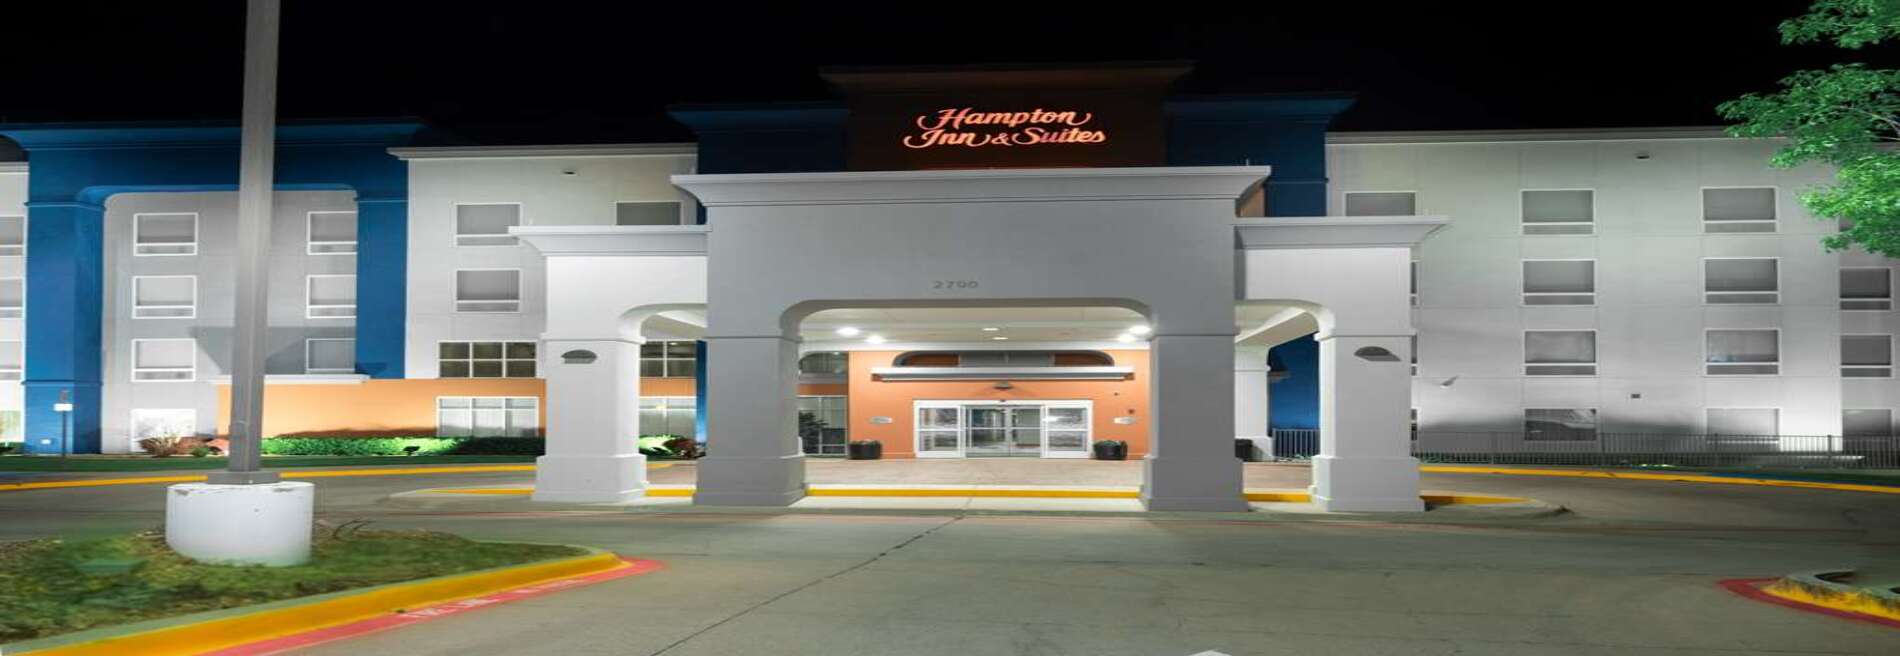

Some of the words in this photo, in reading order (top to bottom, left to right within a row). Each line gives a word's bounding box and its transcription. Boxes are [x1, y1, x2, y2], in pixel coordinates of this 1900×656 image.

[917, 107, 1091, 129] Hampton
[903, 129, 990, 148] Inn
[991, 132, 1013, 146] &
[1012, 127, 1106, 145] Suites
